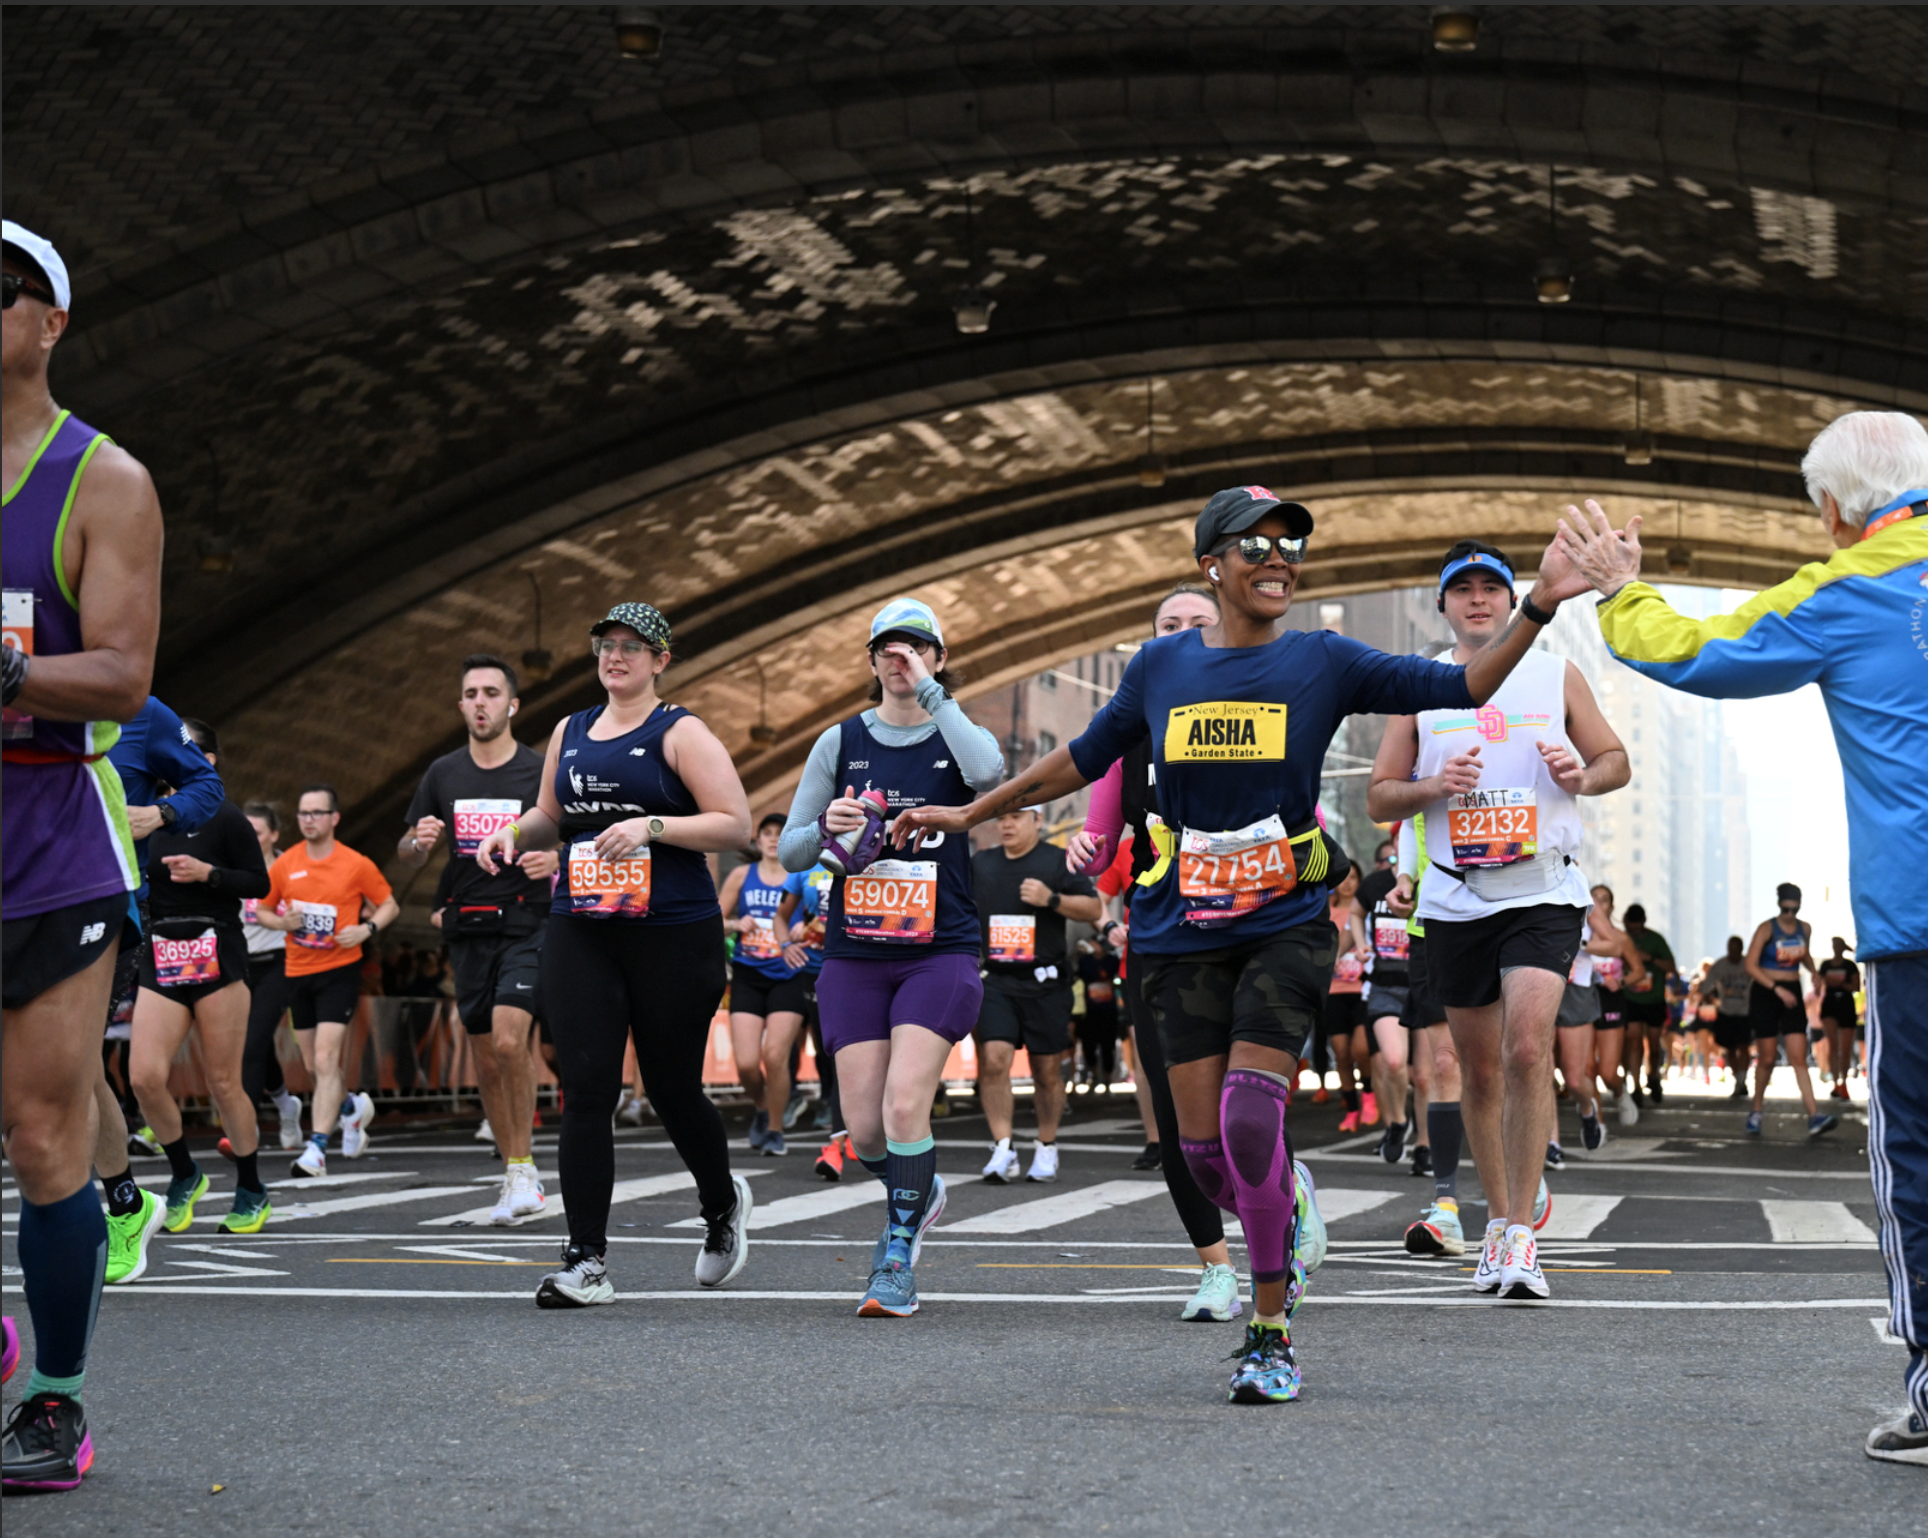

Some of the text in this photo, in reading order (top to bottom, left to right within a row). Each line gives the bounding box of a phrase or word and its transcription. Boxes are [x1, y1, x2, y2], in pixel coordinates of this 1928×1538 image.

[1244, 485, 1280, 502] R
[1193, 704, 1258, 716] New Jersey
[1187, 718, 1256, 746] AISHA
[1476, 704, 1508, 743] SD
[628, 747, 646, 756] NB
[1192, 748, 1255, 758] Garden State
[848, 761, 869, 770] 2023
[932, 760, 948, 769] NB
[888, 789, 900, 797] tcs
[1465, 789, 1508, 808] MATT
[1456, 808, 1530, 836] 32132
[1191, 834, 1208, 852] tcs
[572, 861, 645, 887] 59555
[1187, 844, 1286, 886] 27754
[850, 880, 929, 908] 59074
[1201, 887, 1207, 895] 3
[303, 914, 334, 932] 839
[80, 922, 106, 946] NB
[990, 927, 1030, 944] 61525
[158, 939, 212, 961] 36925
